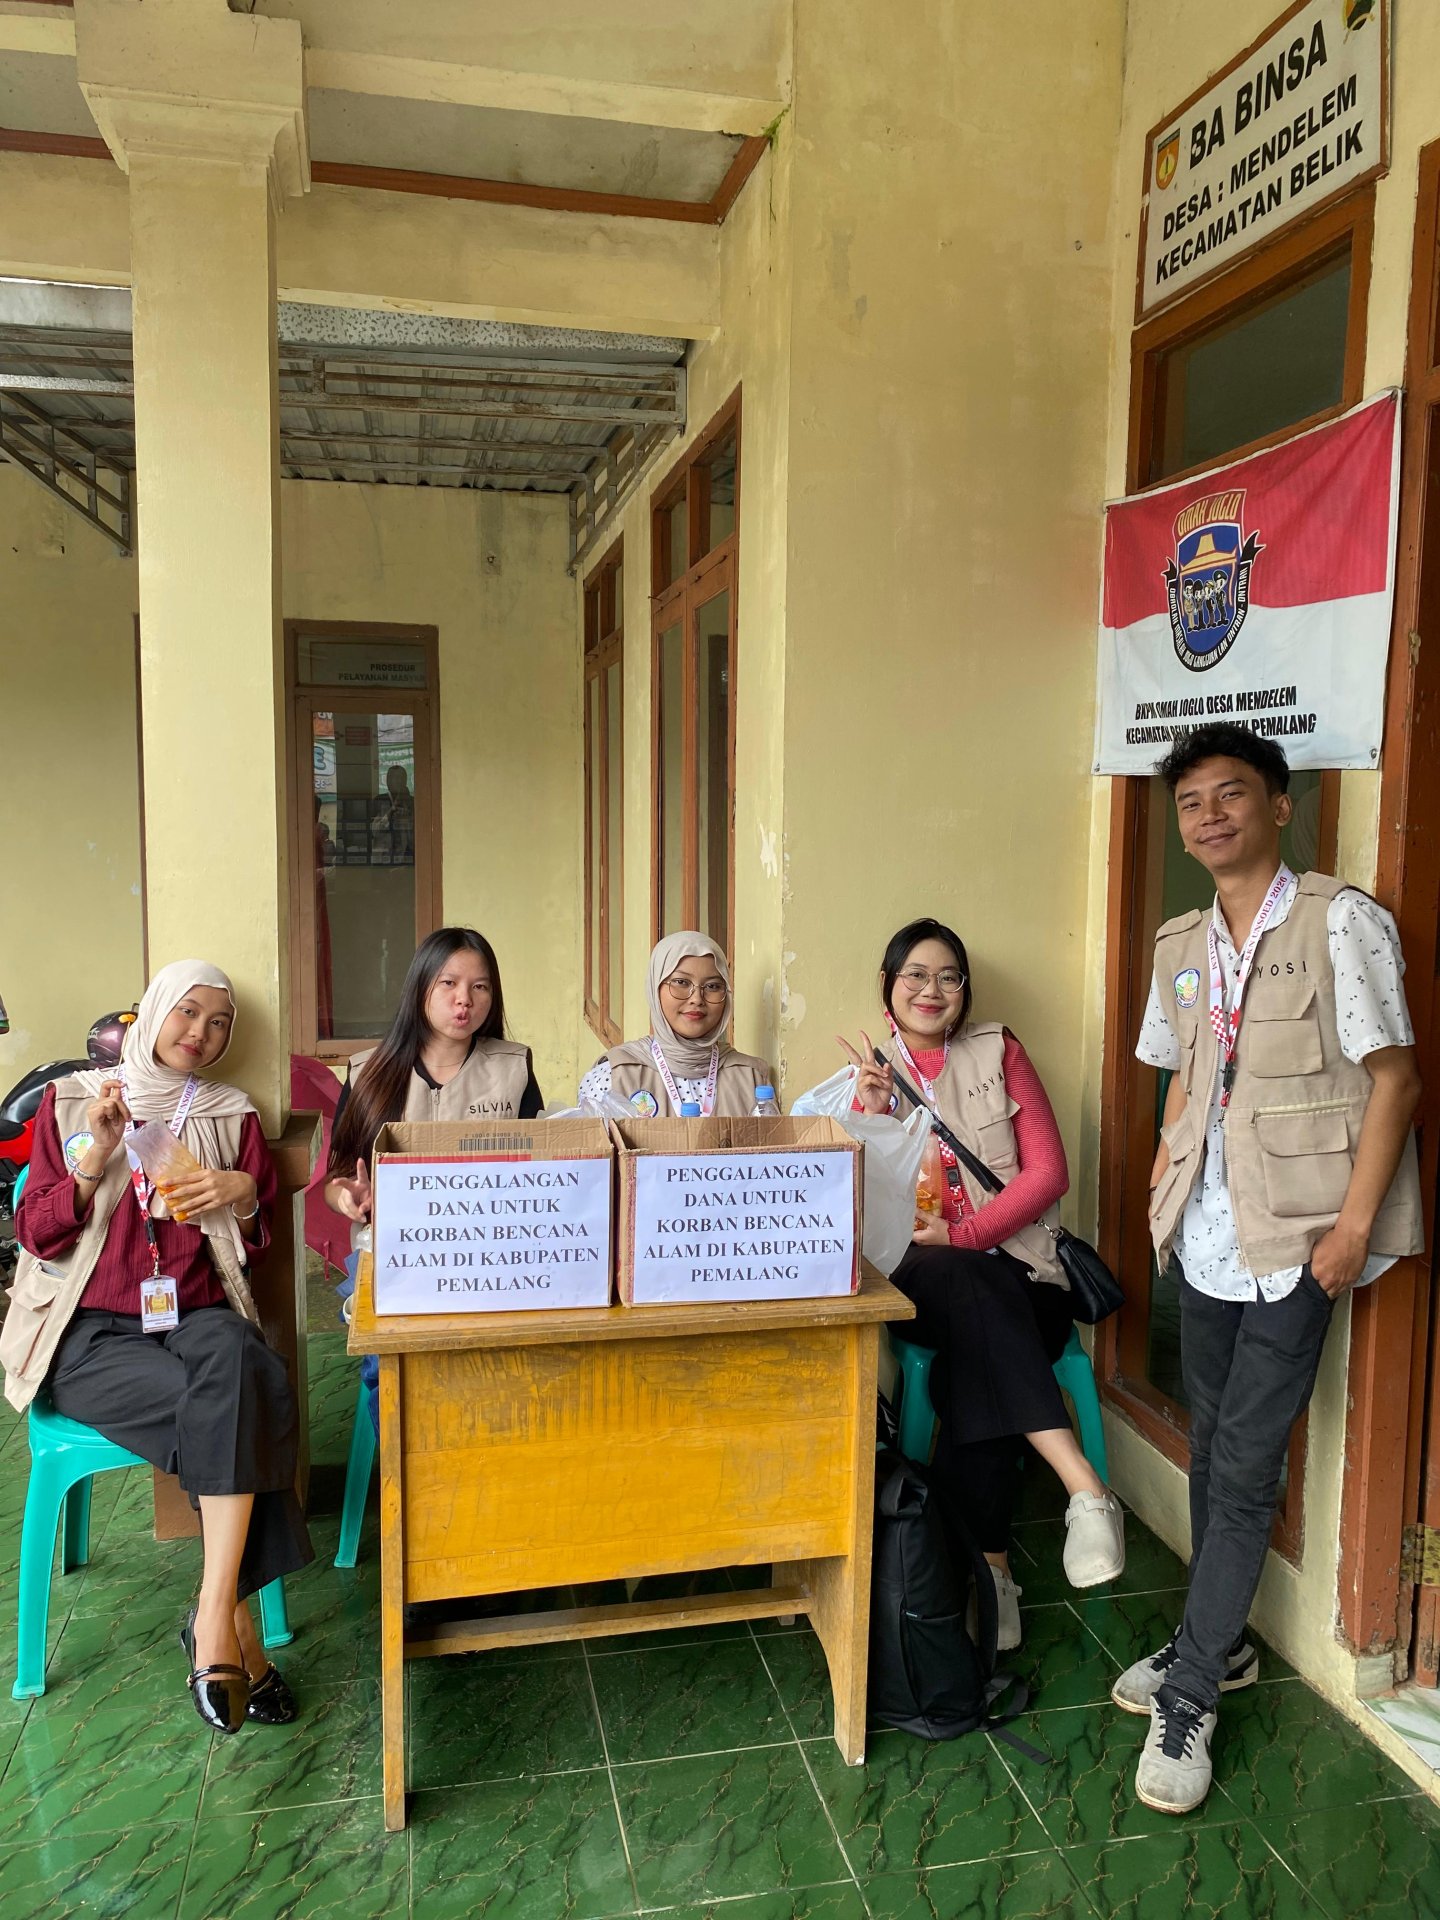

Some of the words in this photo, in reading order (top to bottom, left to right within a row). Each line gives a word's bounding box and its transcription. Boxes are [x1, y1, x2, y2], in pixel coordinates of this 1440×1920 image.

[1189, 105, 1225, 170] BA
[1234, 19, 1328, 136] BINSA
[1163, 184, 1212, 241] DESA
[1230, 73, 1357, 194] MENDELEM
[1156, 175, 1282, 285] KECAMATAN
[1290, 119, 1363, 198] BELIK
[1177, 500, 1207, 537] OMAH
[1206, 493, 1241, 522] JOGLO
[338, 672, 388, 681] PELAYANAN
[370, 663, 415, 672] PROSEDUR
[1178, 697, 1205, 717] JOGLO
[1207, 694, 1233, 715] DESA
[1236, 686, 1297, 711] MENDELEM
[1126, 724, 1173, 744] KECAMATAN
[1252, 713, 1317, 737] PEMALANG
[1245, 941, 1255, 961] KKN
[1252, 899, 1273, 938] UNSOED
[1270, 876, 1288, 899] 2026
[1257, 961, 1307, 978] YOSI
[660, 1060, 679, 1101] MENDELEM
[170, 1115, 184, 1133] KKN
[177, 1083, 195, 1114] UNSOED
[469, 1101, 513, 1114] SILVIA
[408, 1171, 580, 1190] PENGGALANGAN
[666, 1163, 825, 1182] PENGGALANGAN
[428, 1201, 485, 1216] DANA
[490, 1198, 561, 1215] UNTUK
[684, 1192, 736, 1207] DANA
[742, 1189, 807, 1205] UNTUK
[399, 1226, 486, 1242] KORBAN
[493, 1223, 589, 1240] BENCANA
[656, 1216, 738, 1233] KORBAN
[744, 1214, 834, 1230] BENCANA
[386, 1252, 446, 1268] ALAM
[453, 1252, 473, 1267] DI
[481, 1247, 600, 1266] KABUPATEN
[644, 1243, 700, 1259] ALAM
[707, 1243, 726, 1257] DI
[733, 1238, 845, 1256] KABUPATEN
[691, 1265, 799, 1282] PEMALANG
[436, 1275, 551, 1292] PEMALANG
